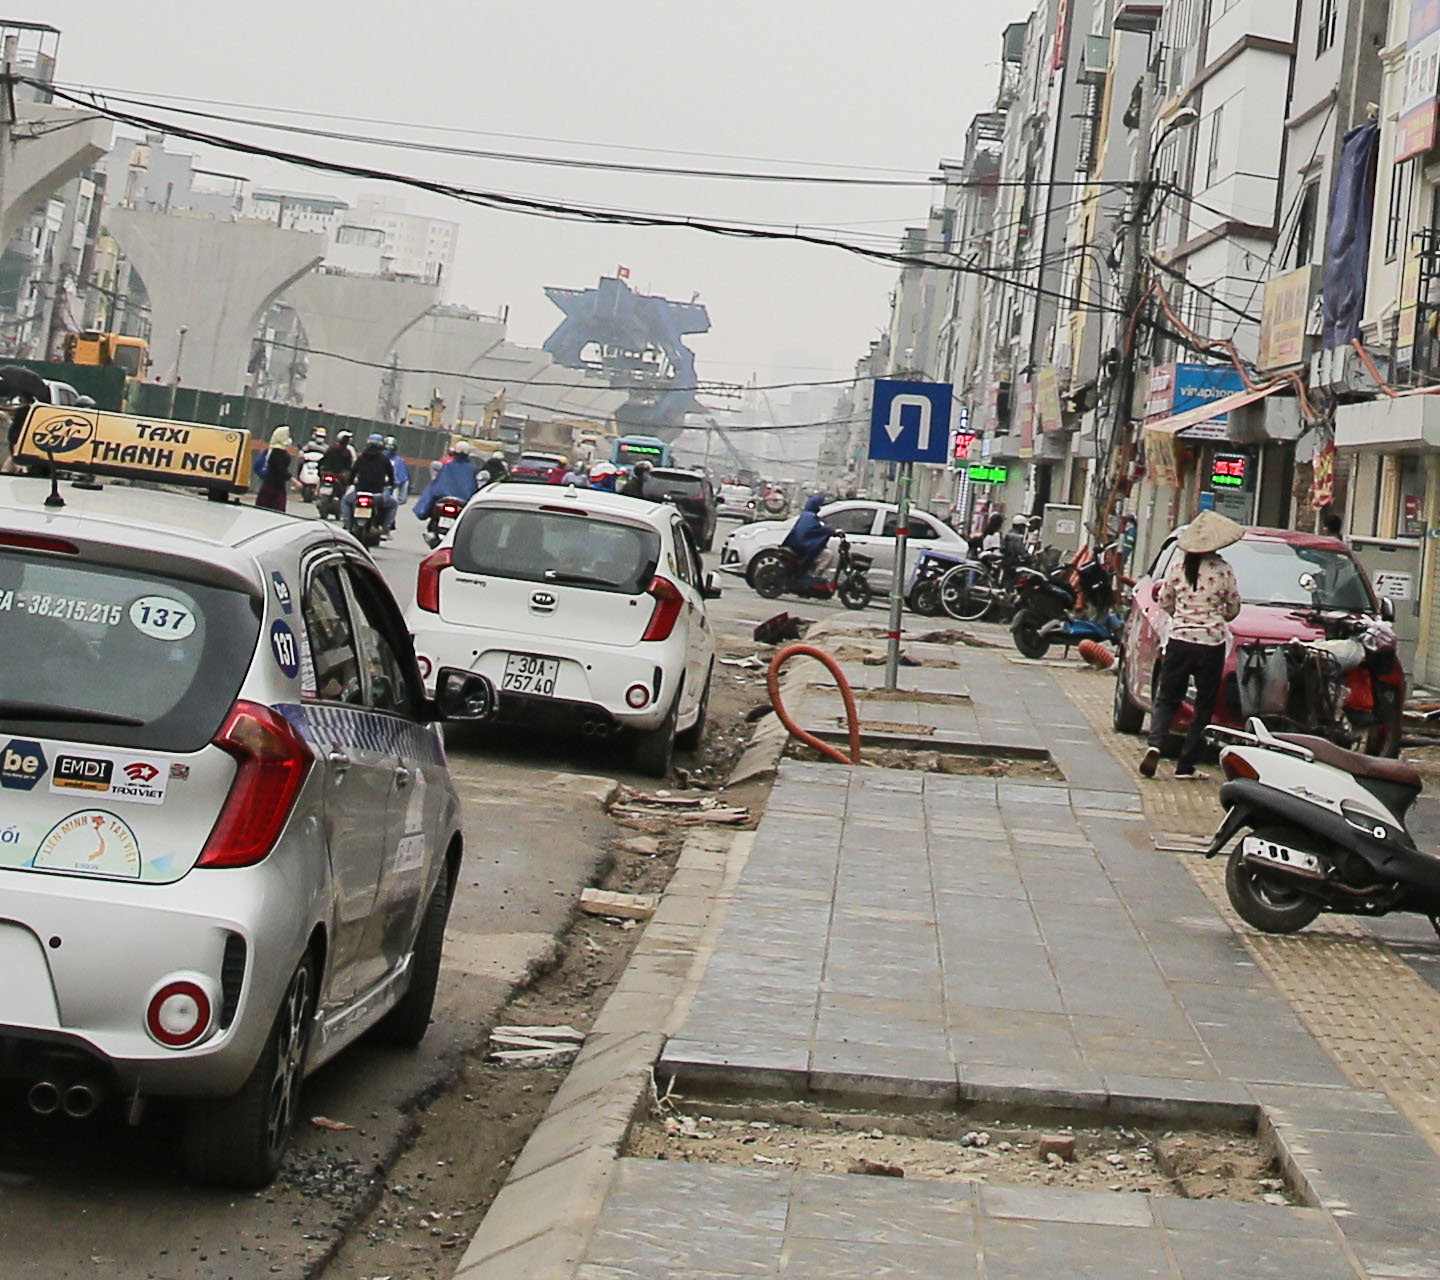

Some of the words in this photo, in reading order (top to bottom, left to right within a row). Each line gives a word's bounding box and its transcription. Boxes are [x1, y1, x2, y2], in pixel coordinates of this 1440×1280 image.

[136, 424, 190, 444] TAXI
[91, 440, 172, 467] THANH
[181, 452, 235, 476] NGA
[27, 594, 122, 626] 38.215.215
[140, 605, 188, 630] 137
[273, 631, 296, 666] 137
[518, 657, 545, 676] 30A
[504, 673, 554, 694] 757.40
[3, 749, 39, 773] be
[61, 758, 107, 778] EMDI
